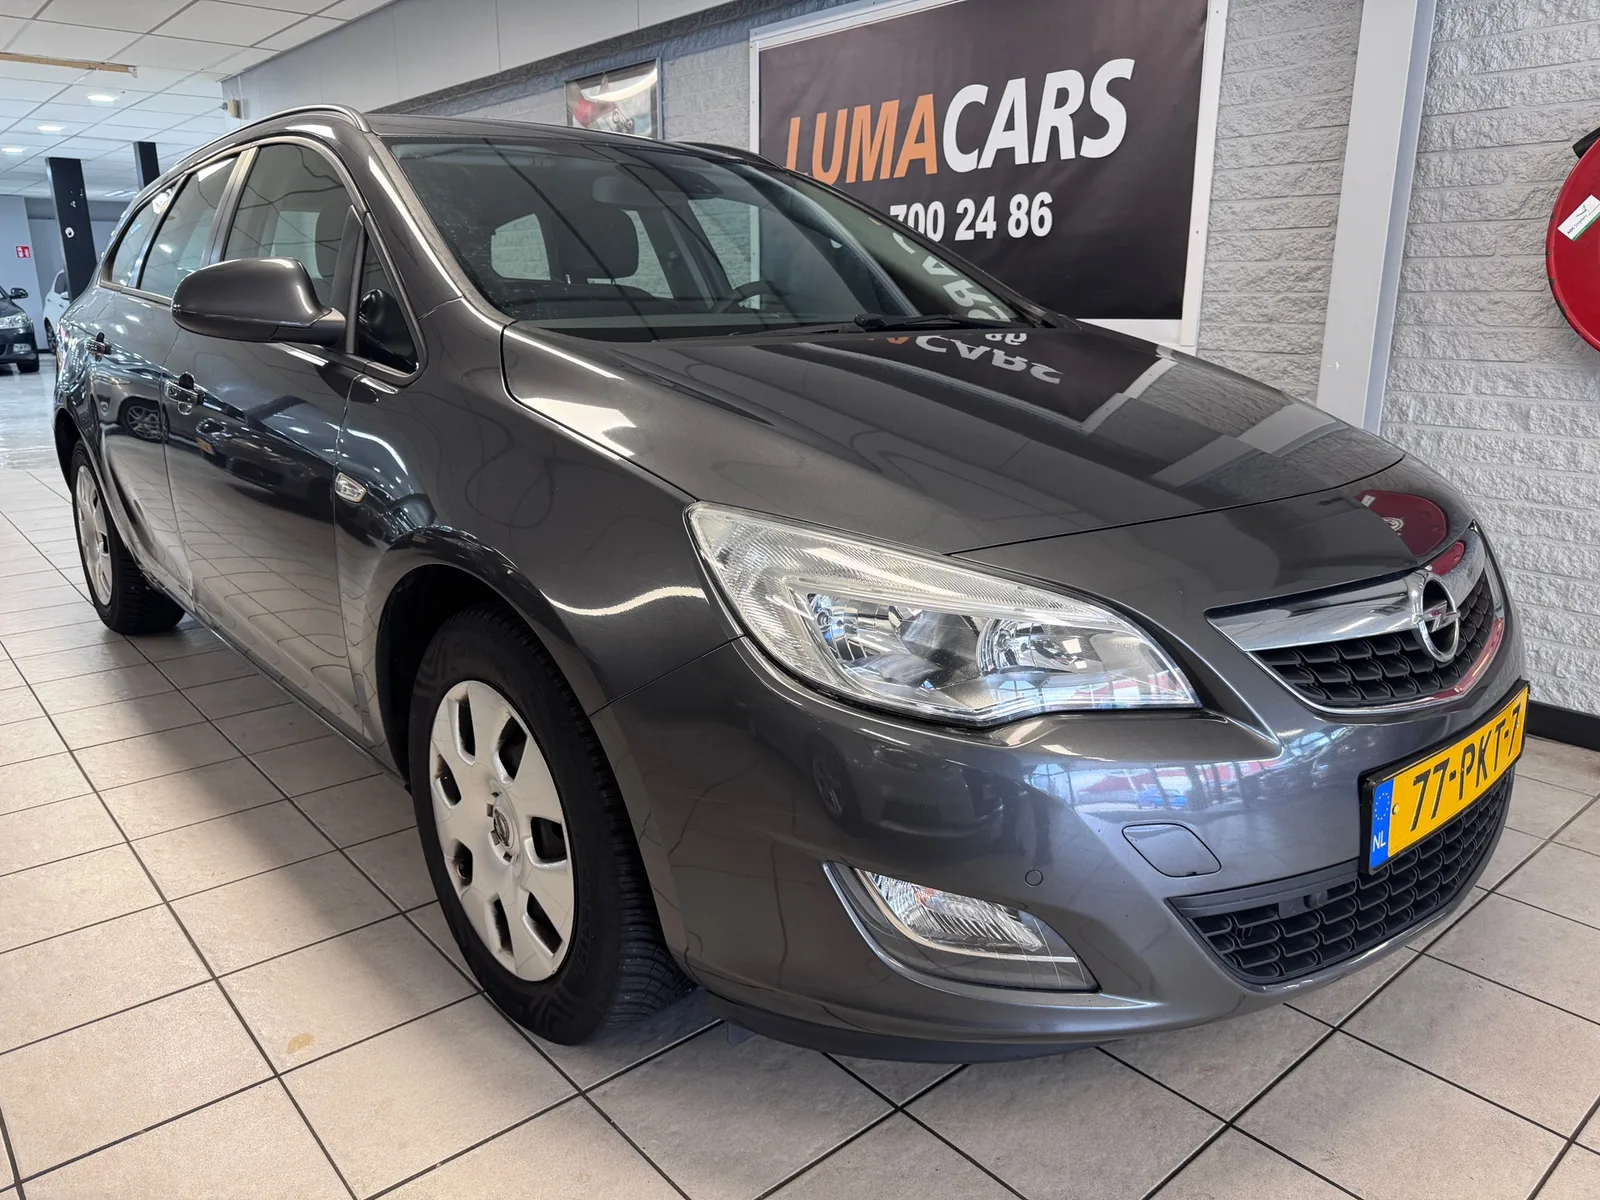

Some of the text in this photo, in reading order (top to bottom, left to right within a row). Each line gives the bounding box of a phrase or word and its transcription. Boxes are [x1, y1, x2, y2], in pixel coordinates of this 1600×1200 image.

[955, 196, 997, 241] 24
[1007, 191, 1053, 238] 86
[1410, 702, 1522, 832] 77-PKT-7
[1372, 830, 1387, 852] NL
